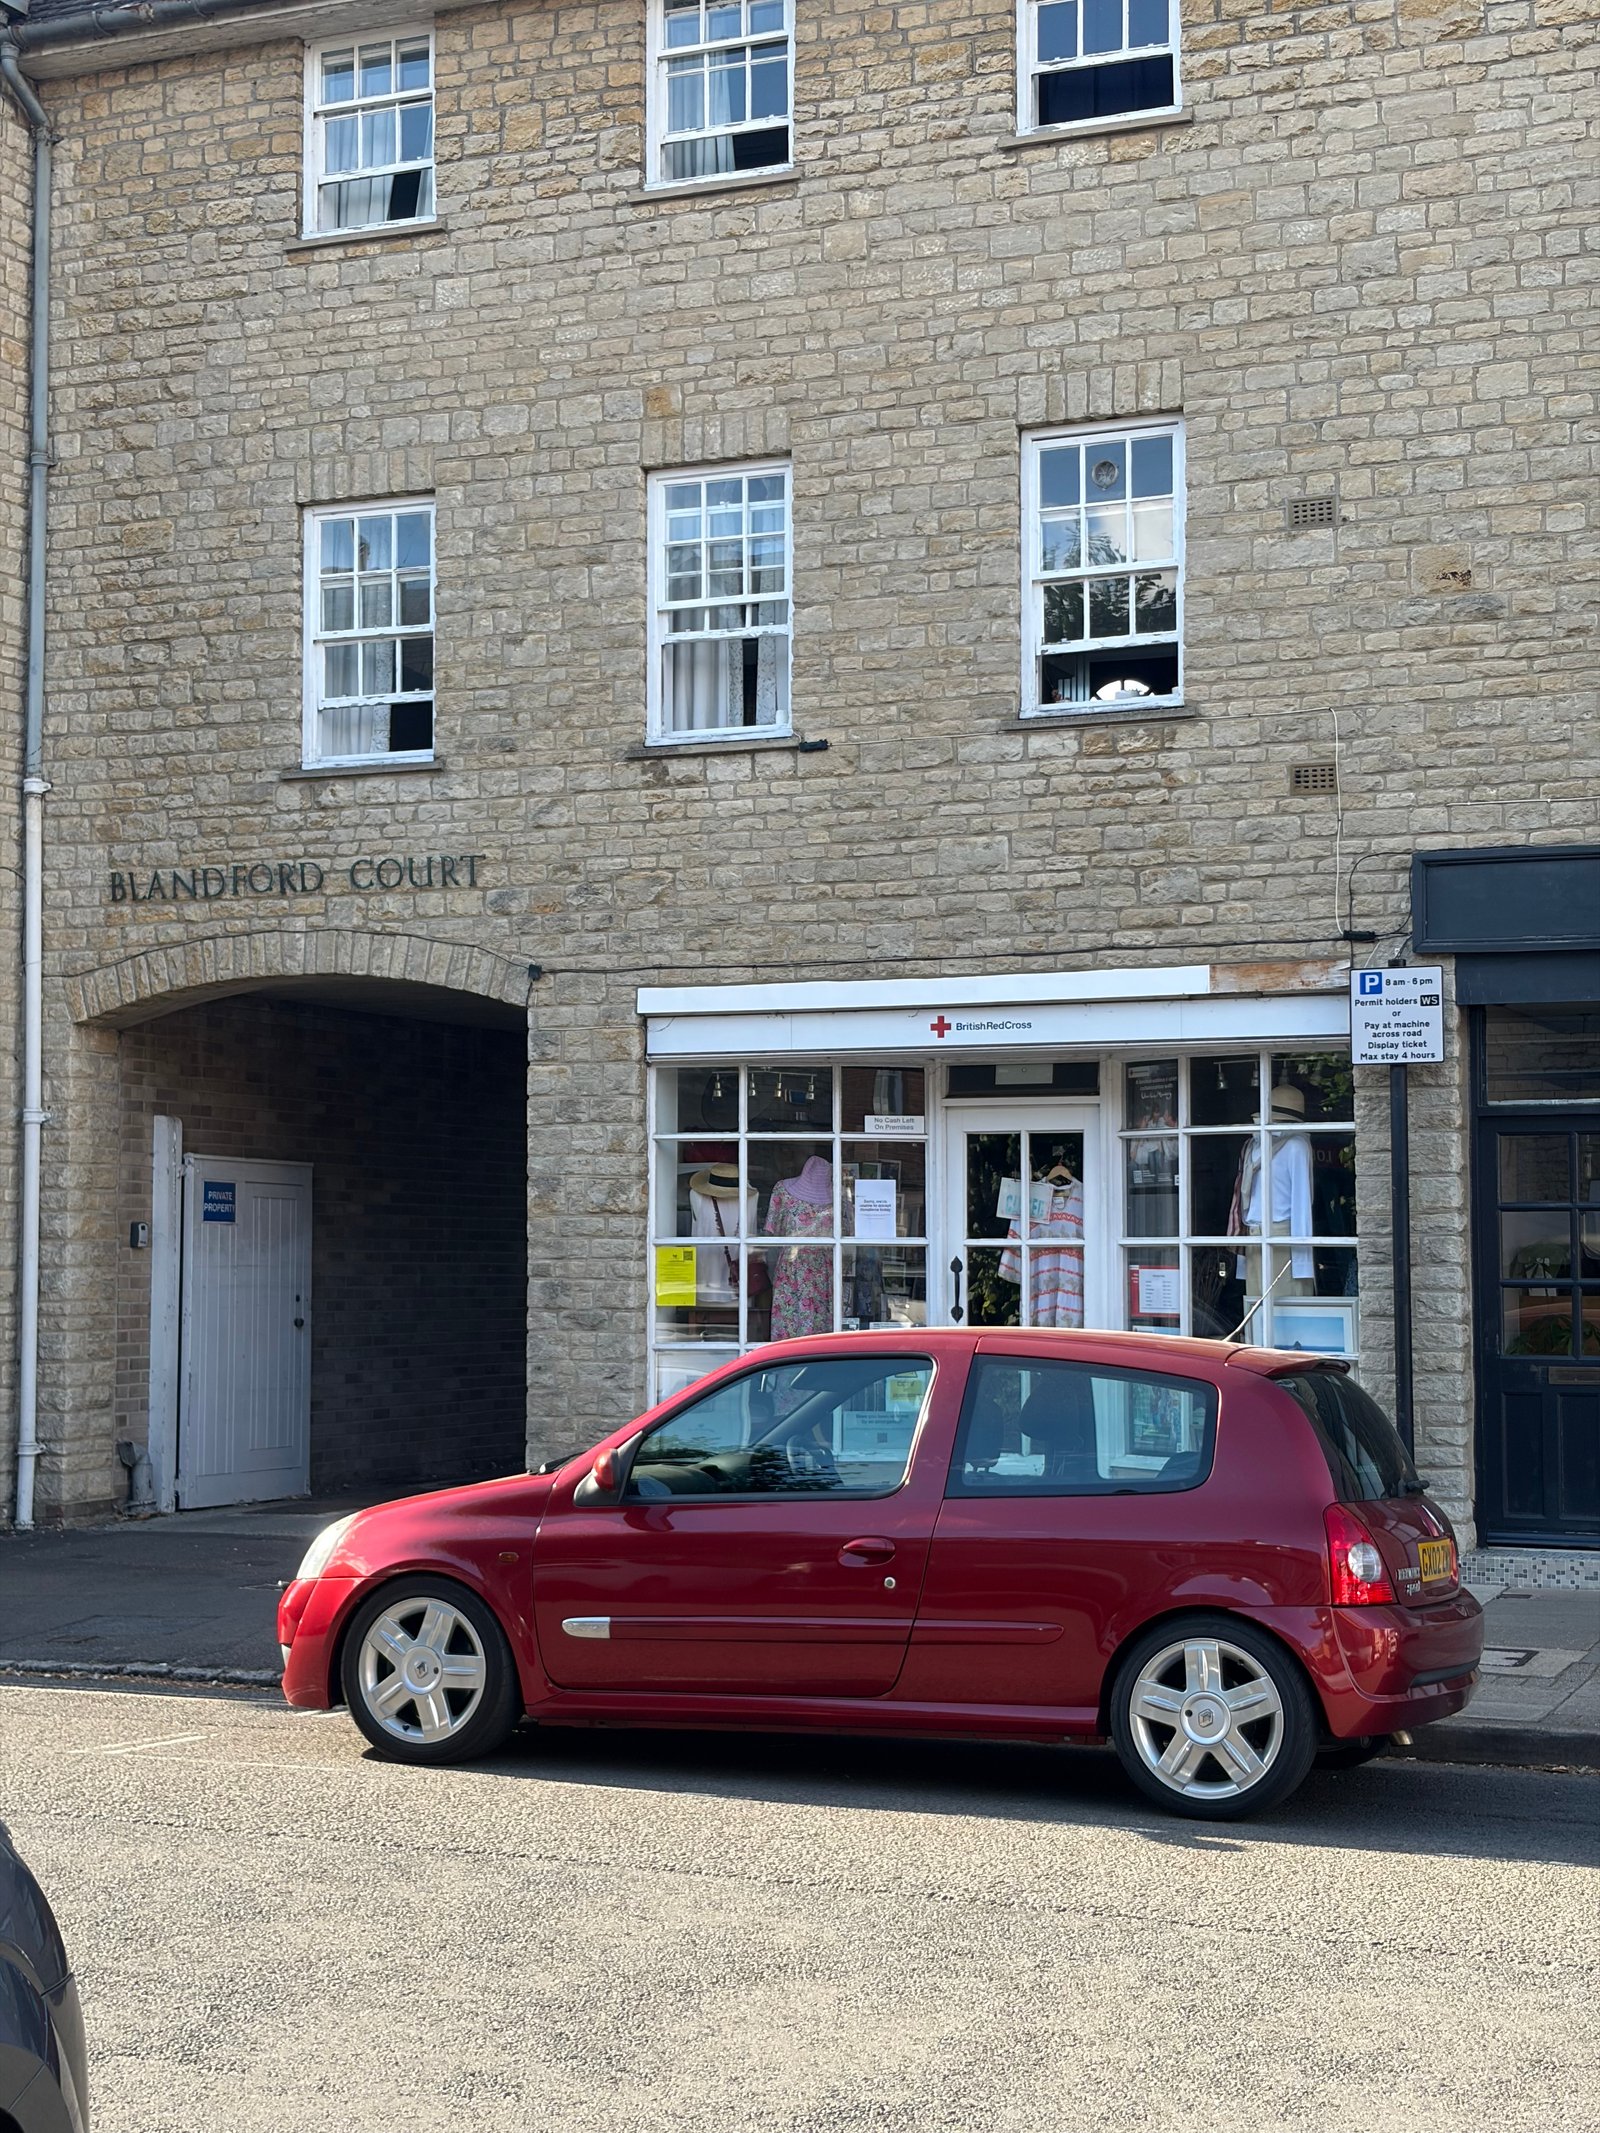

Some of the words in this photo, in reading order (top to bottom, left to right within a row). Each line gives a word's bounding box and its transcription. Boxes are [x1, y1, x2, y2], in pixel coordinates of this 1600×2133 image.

[110, 862, 324, 901] BLANDFORD
[350, 853, 486, 890] COURT
[1365, 974, 1379, 993] P
[1419, 978, 1433, 986] pm
[1354, 998, 1383, 1007] Permit
[1385, 998, 1418, 1006] holders
[1421, 996, 1438, 1005] WS
[1364, 1022, 1379, 1031] Pay
[1382, 1021, 1391, 1029] at
[1394, 1020, 1430, 1029] machine
[1368, 1041, 1399, 1050] Display
[1360, 1053, 1378, 1061] Max
[1381, 1053, 1399, 1061] stay
[1410, 1051, 1436, 1059] hours
[208, 1190, 233, 1201] PRIVATE
[204, 1202, 236, 1213] PROPERTY
[1421, 1545, 1442, 1577] GX02
